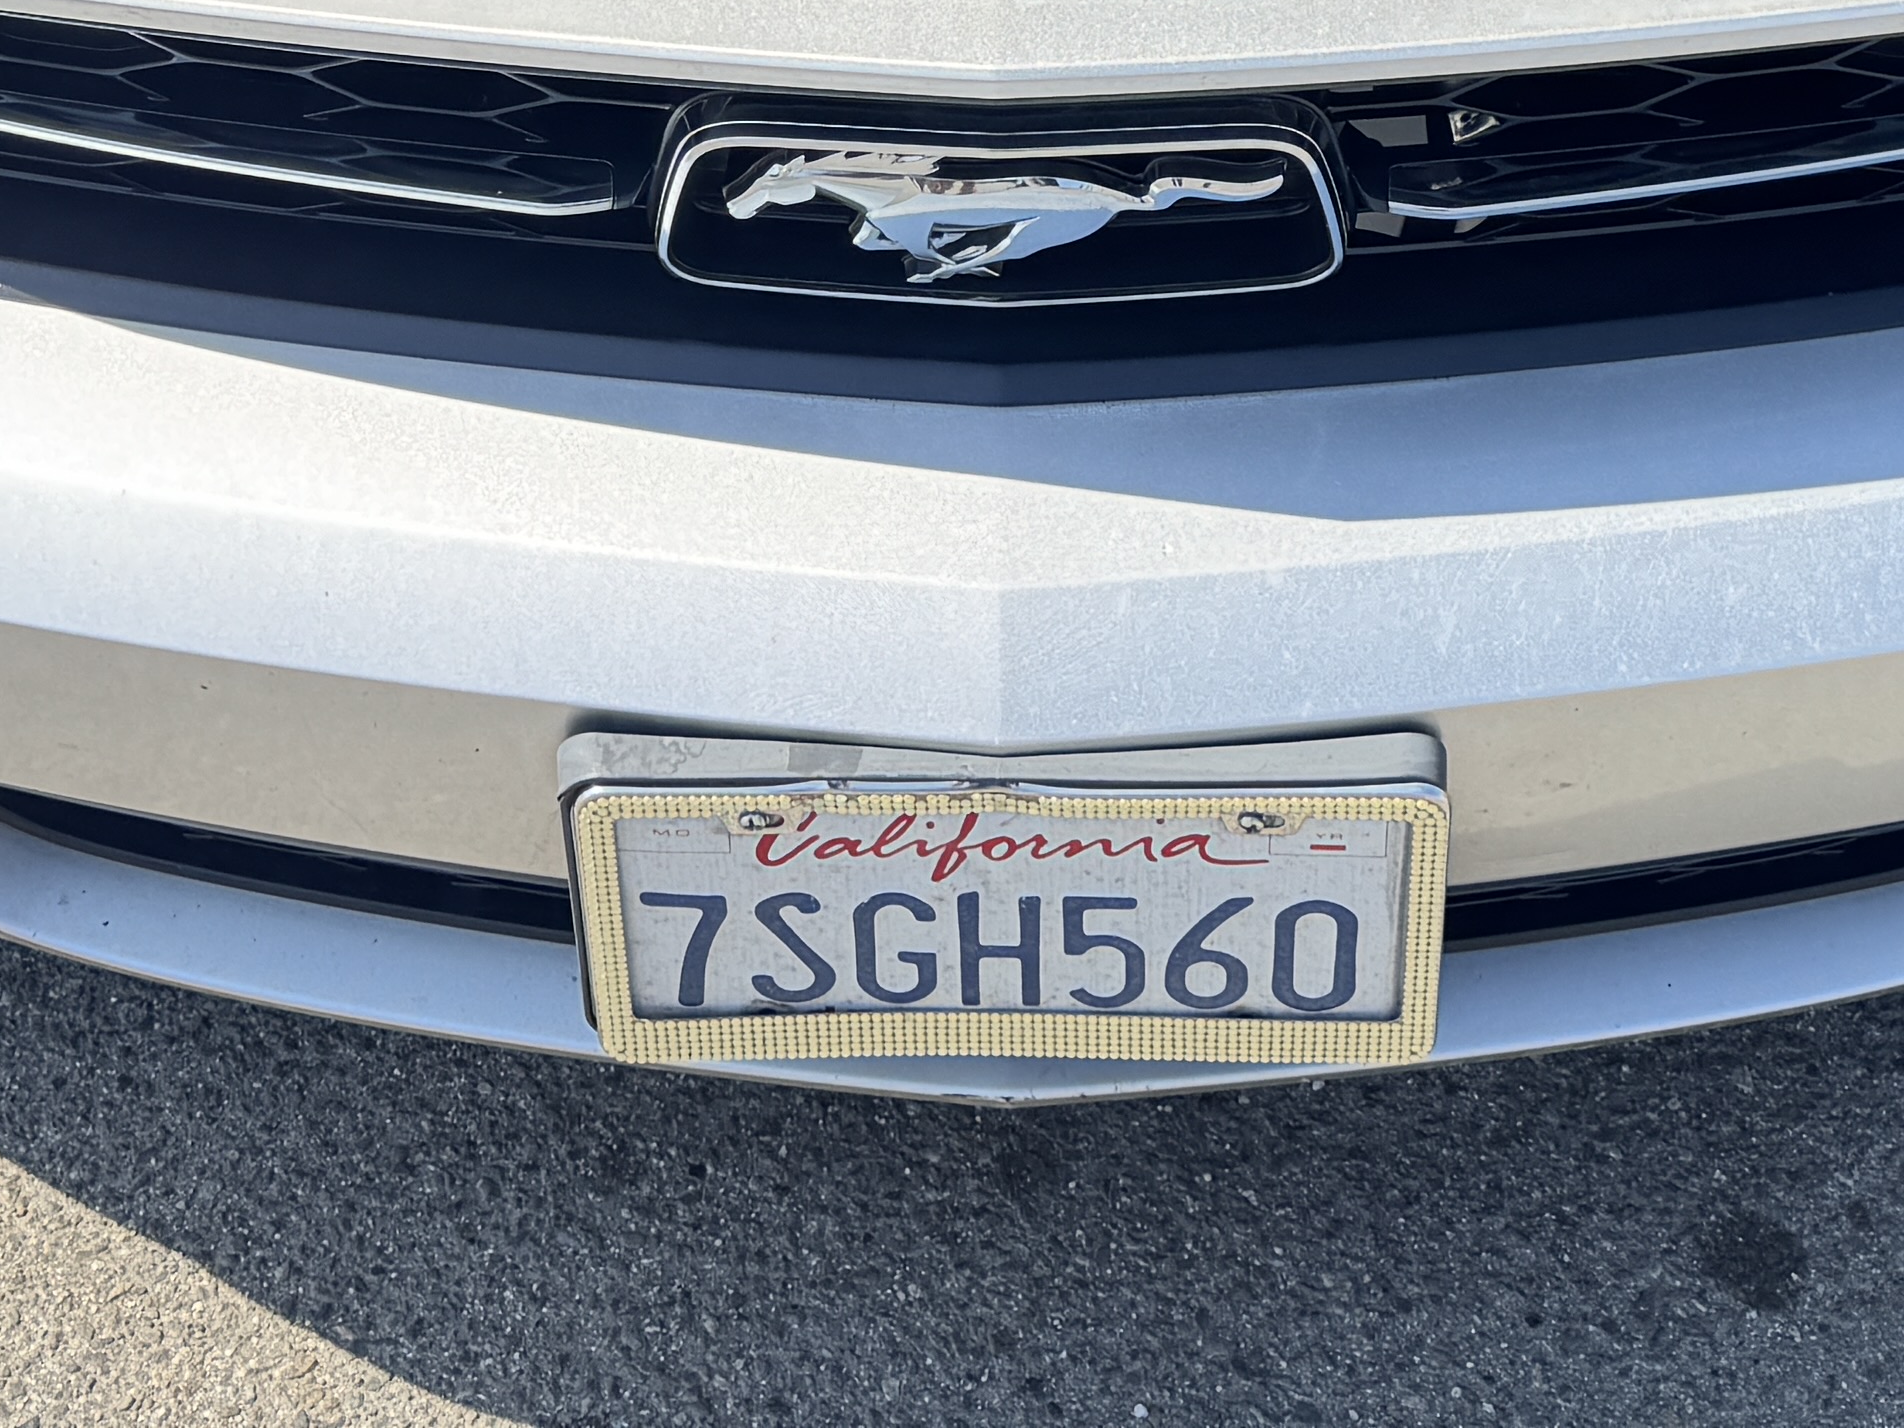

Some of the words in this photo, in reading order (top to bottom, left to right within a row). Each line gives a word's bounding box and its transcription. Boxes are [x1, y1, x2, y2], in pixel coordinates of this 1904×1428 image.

[652, 828, 691, 838] MO
[755, 811, 1270, 882] California
[639, 891, 1359, 1012] 7SGH560
